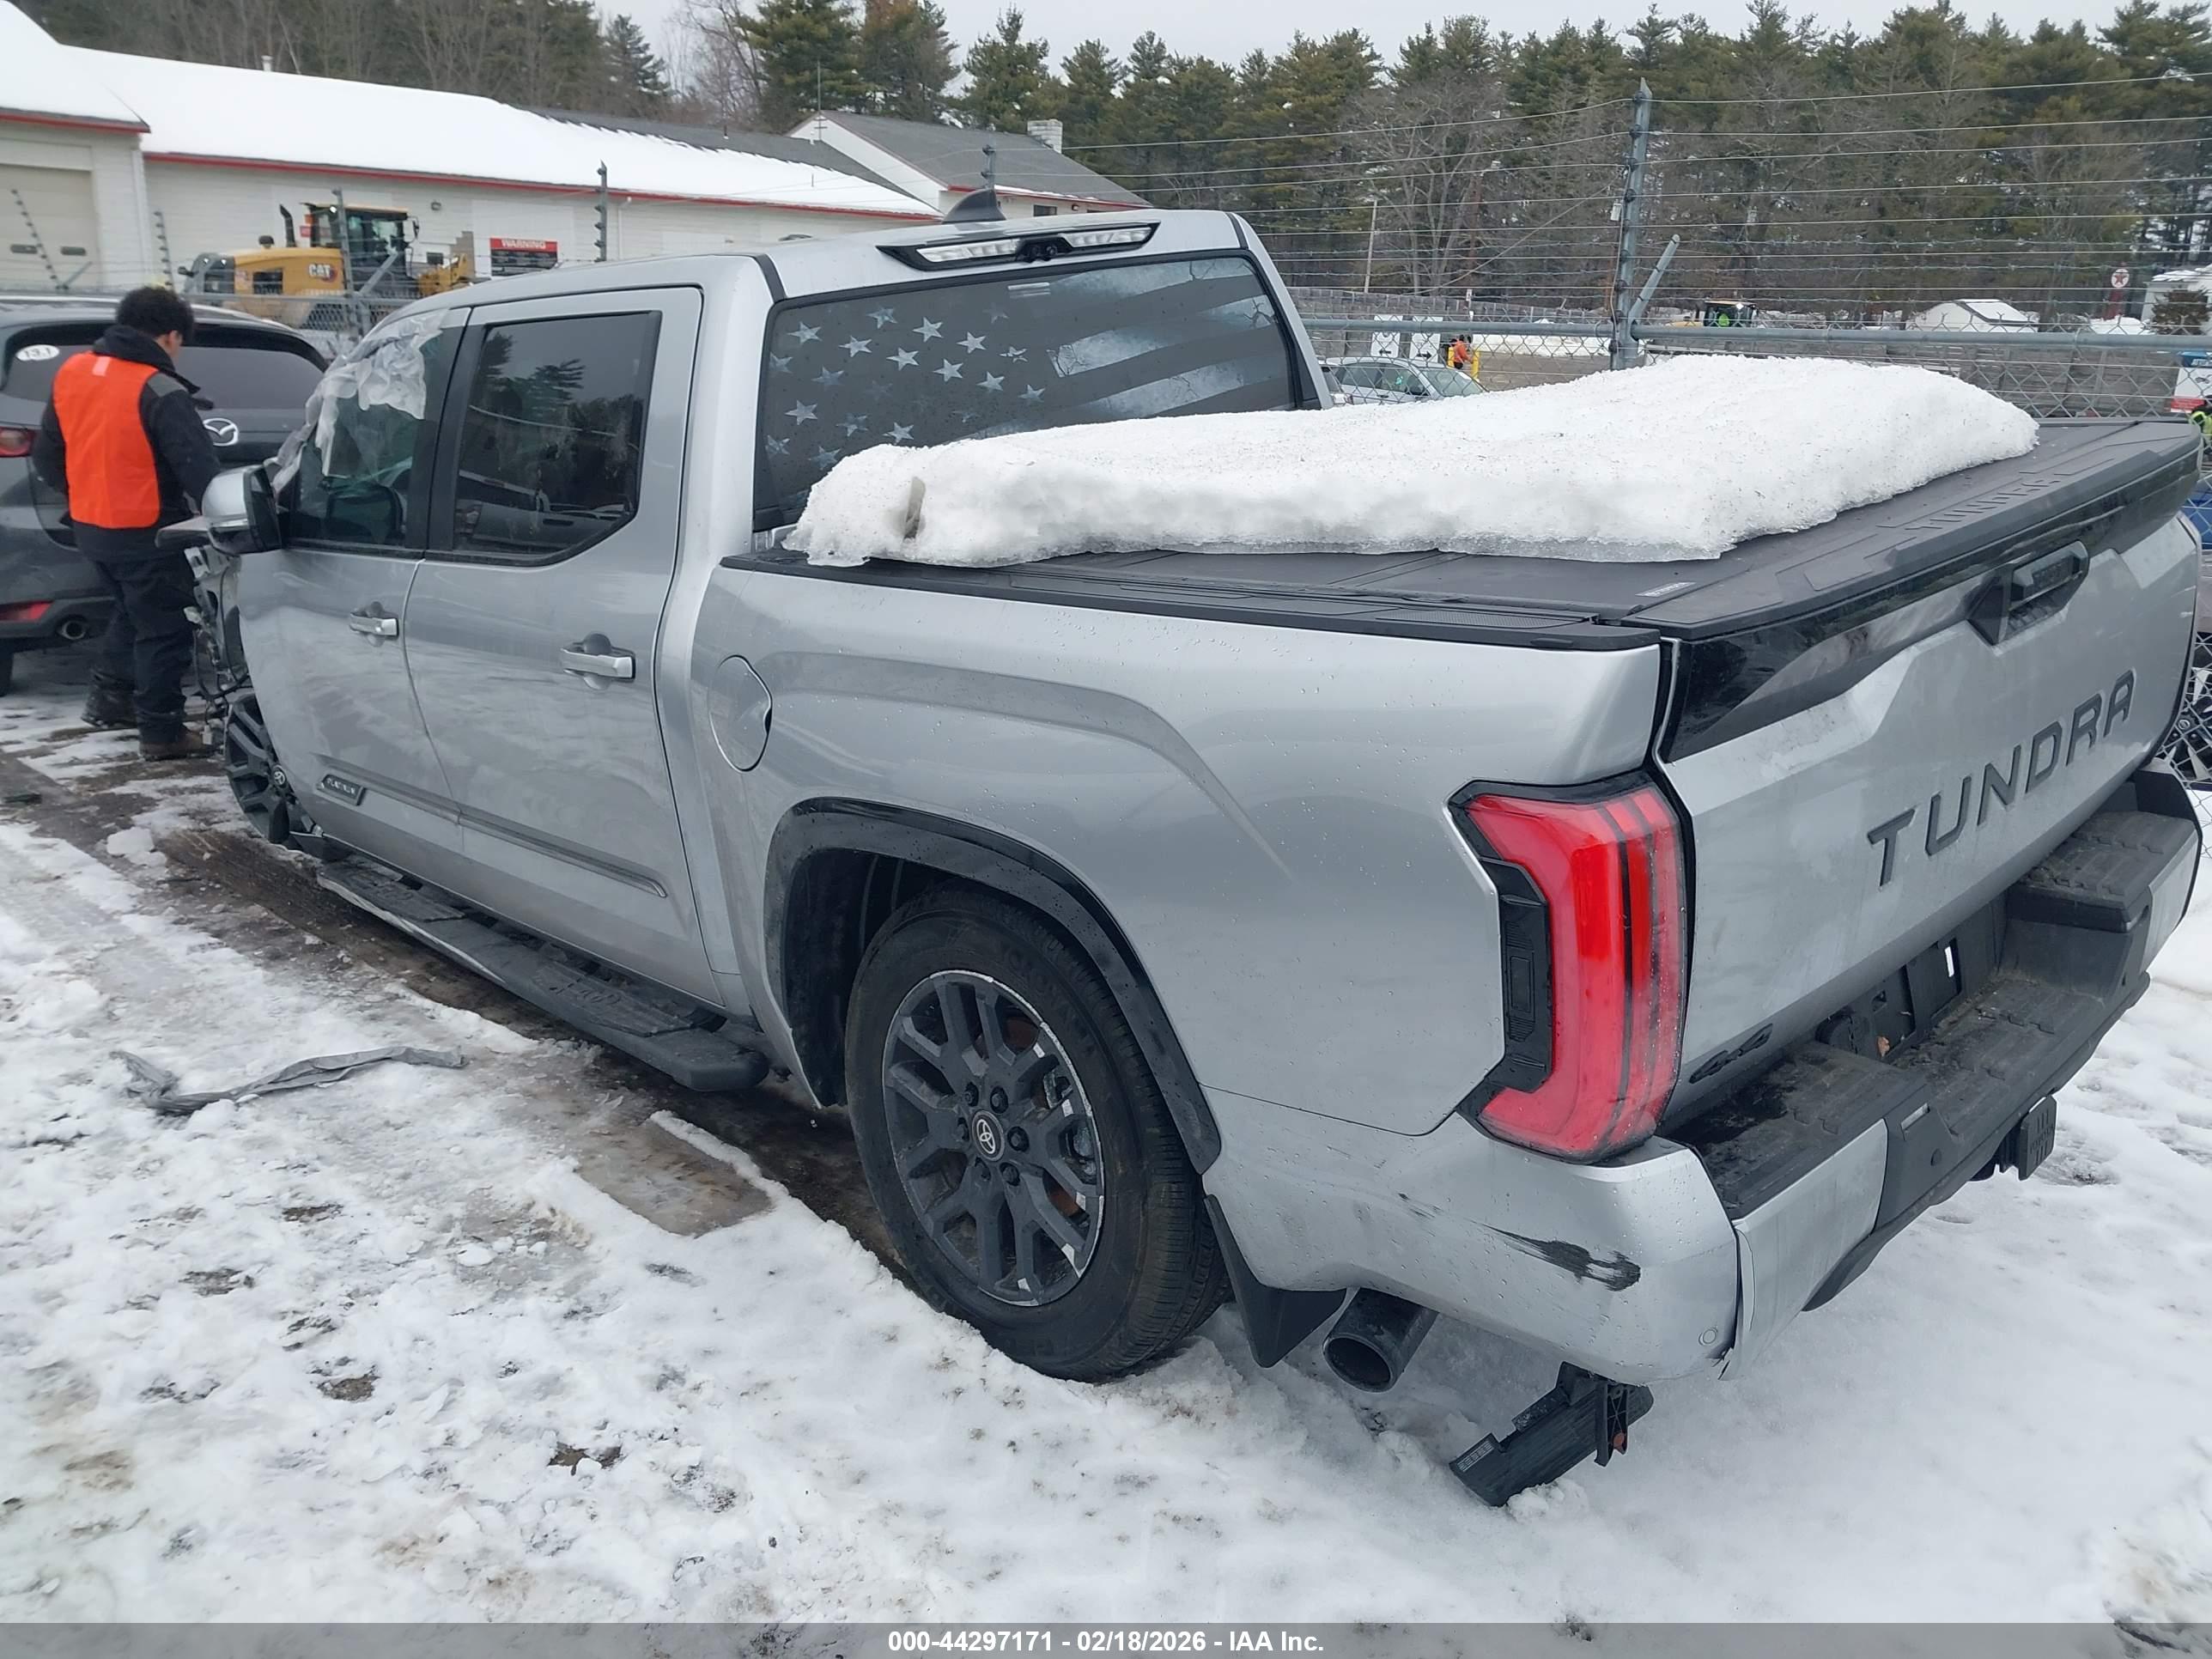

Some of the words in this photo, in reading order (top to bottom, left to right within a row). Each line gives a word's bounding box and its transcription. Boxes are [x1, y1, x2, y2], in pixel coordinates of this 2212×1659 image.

[501, 238, 546, 250] WARNING
[308, 263, 330, 278] CAT
[1867, 668, 2136, 890] TUNDRA
